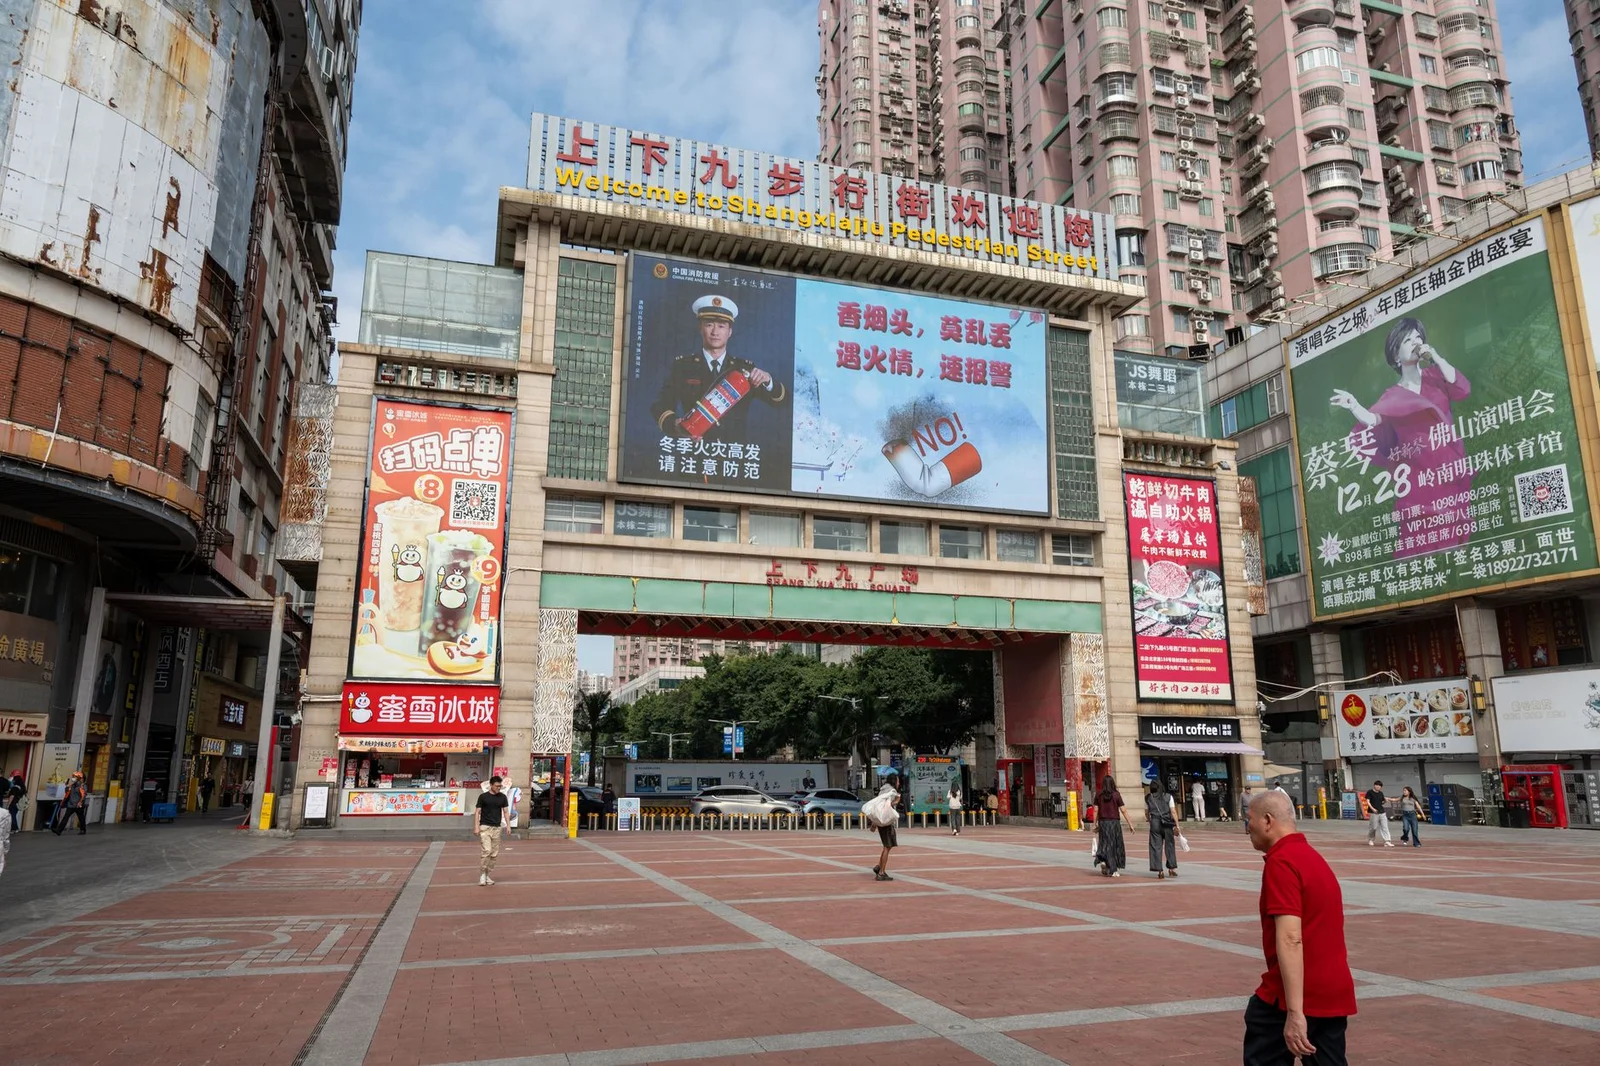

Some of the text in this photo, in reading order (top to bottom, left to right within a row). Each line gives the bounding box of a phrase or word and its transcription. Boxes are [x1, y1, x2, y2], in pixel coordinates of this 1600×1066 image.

[556, 126, 1094, 248] 上下九步行街欢迎您
[556, 166, 1099, 271] Welcome to Shangxiajiu Pedestrian Street
[672, 267, 720, 281] 中国消防救援
[1295, 307, 1368, 359] 演唱会之城
[1377, 226, 1535, 316] 年度压轴金曲盛宴
[836, 301, 1012, 350] 香烟头，莫乱丢
[836, 340, 1013, 389] 遇火情，速报警
[912, 412, 967, 457] NO!
[1428, 389, 1555, 452] 佛山演唱会
[380, 427, 503, 477] 扫码点单
[659, 435, 761, 461] 冬季火灾高发
[1303, 425, 1378, 493] 蔡琴
[1418, 430, 1563, 488] 岭南明珠体育馆
[658, 455, 760, 480] 请注意防范
[422, 479, 440, 499] 8
[1147, 480, 1210, 503] 鲜切牛肉
[1149, 503, 1212, 524] 自助火锅
[1141, 545, 1208, 559] 牛肉不新鲜不收费
[481, 560, 497, 579] 9
[766, 558, 919, 585] 上下九广场
[766, 577, 911, 593] SHANG XIA JIU SQUARE
[377, 694, 495, 724] 蜜雪冰城
[1152, 722, 1218, 736] luckin coffee
